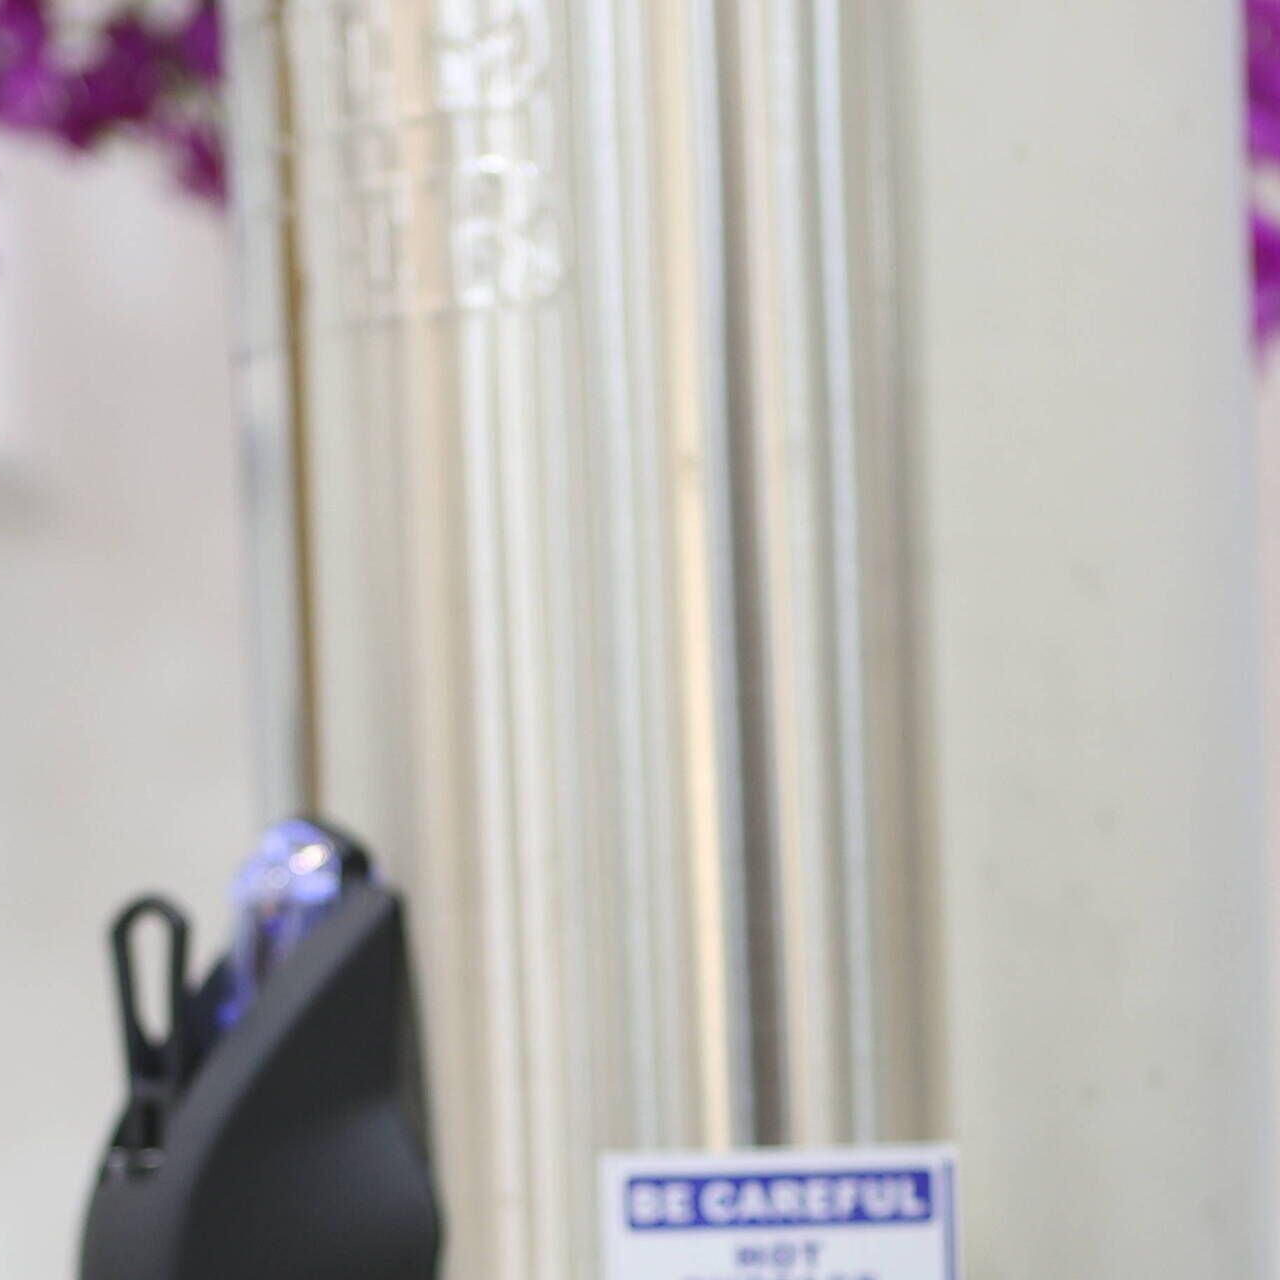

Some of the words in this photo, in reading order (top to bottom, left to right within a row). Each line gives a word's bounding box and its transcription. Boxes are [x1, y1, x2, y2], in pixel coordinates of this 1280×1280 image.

[631, 1181, 694, 1224] BE
[699, 1174, 926, 1224] CAREFUL
[737, 1242, 820, 1268] HOT
